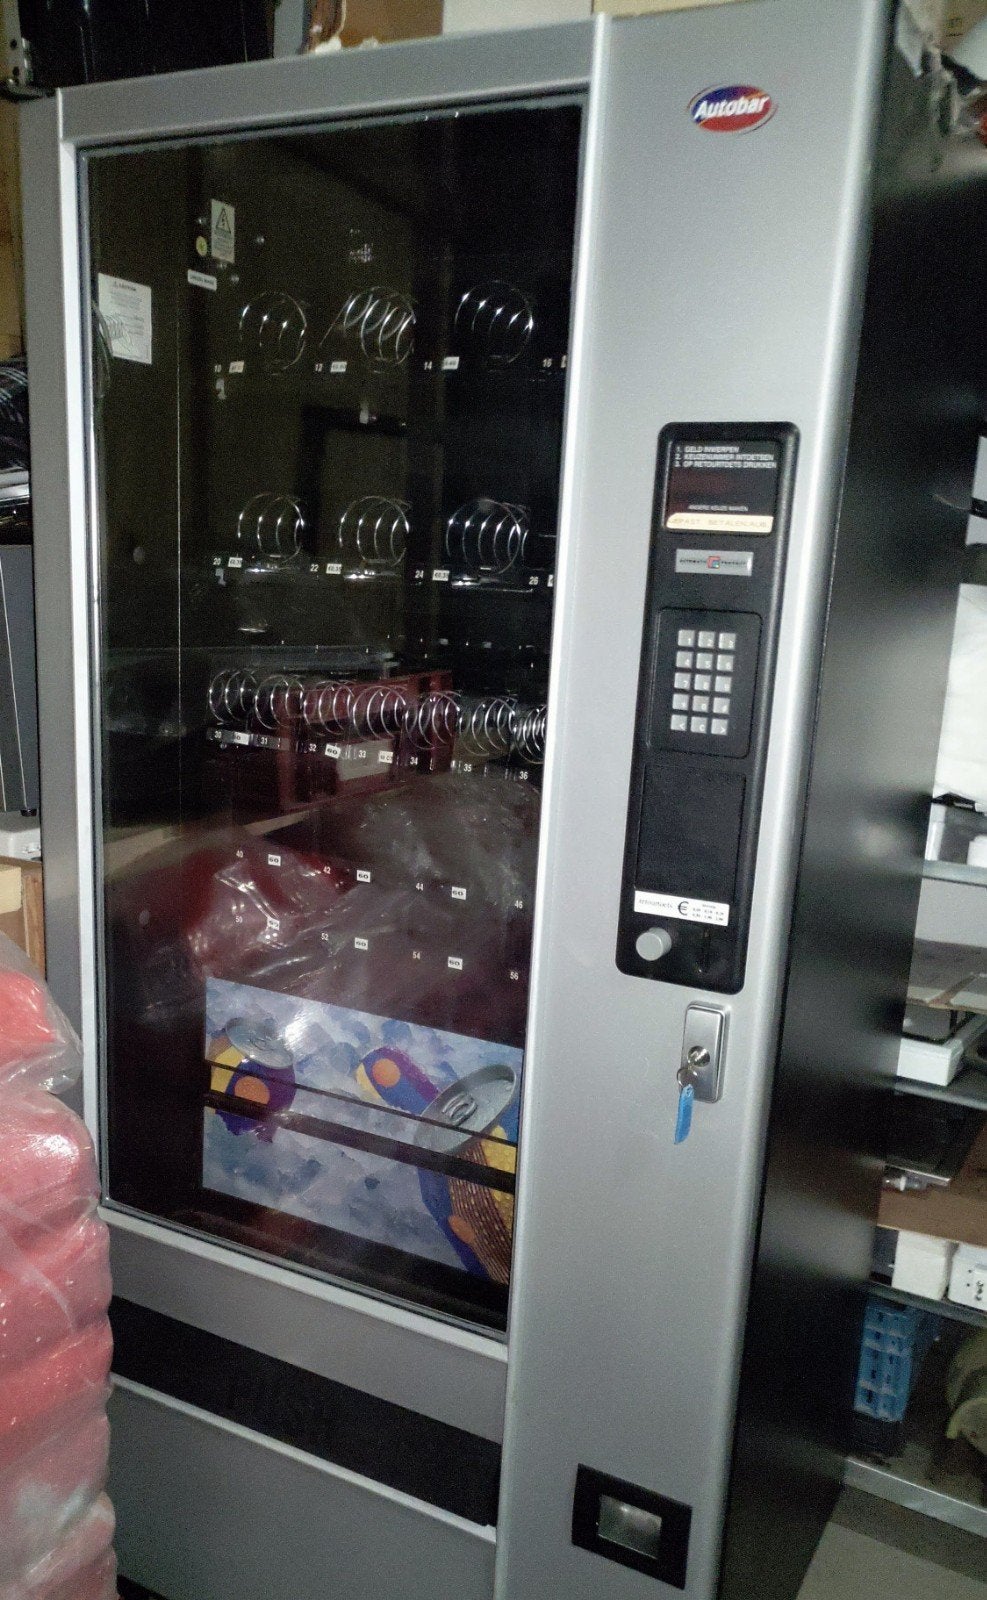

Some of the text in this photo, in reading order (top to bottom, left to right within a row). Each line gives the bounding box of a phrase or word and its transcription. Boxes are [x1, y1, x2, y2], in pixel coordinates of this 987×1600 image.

[693, 96, 770, 120] Autobar
[310, 563, 319, 572] 22
[414, 570, 424, 579] 24
[529, 576, 539, 585] 26
[260, 737, 268, 745] 31
[309, 743, 317, 752] 32
[358, 750, 367, 759] 33
[410, 756, 419, 766] 34
[463, 763, 472, 772] 35
[519, 771, 529, 780] 36
[415, 882, 424, 891] 44
[514, 900, 523, 909] 46
[321, 933, 329, 941] 52
[412, 951, 421, 960] 54
[509, 971, 519, 980] 56
